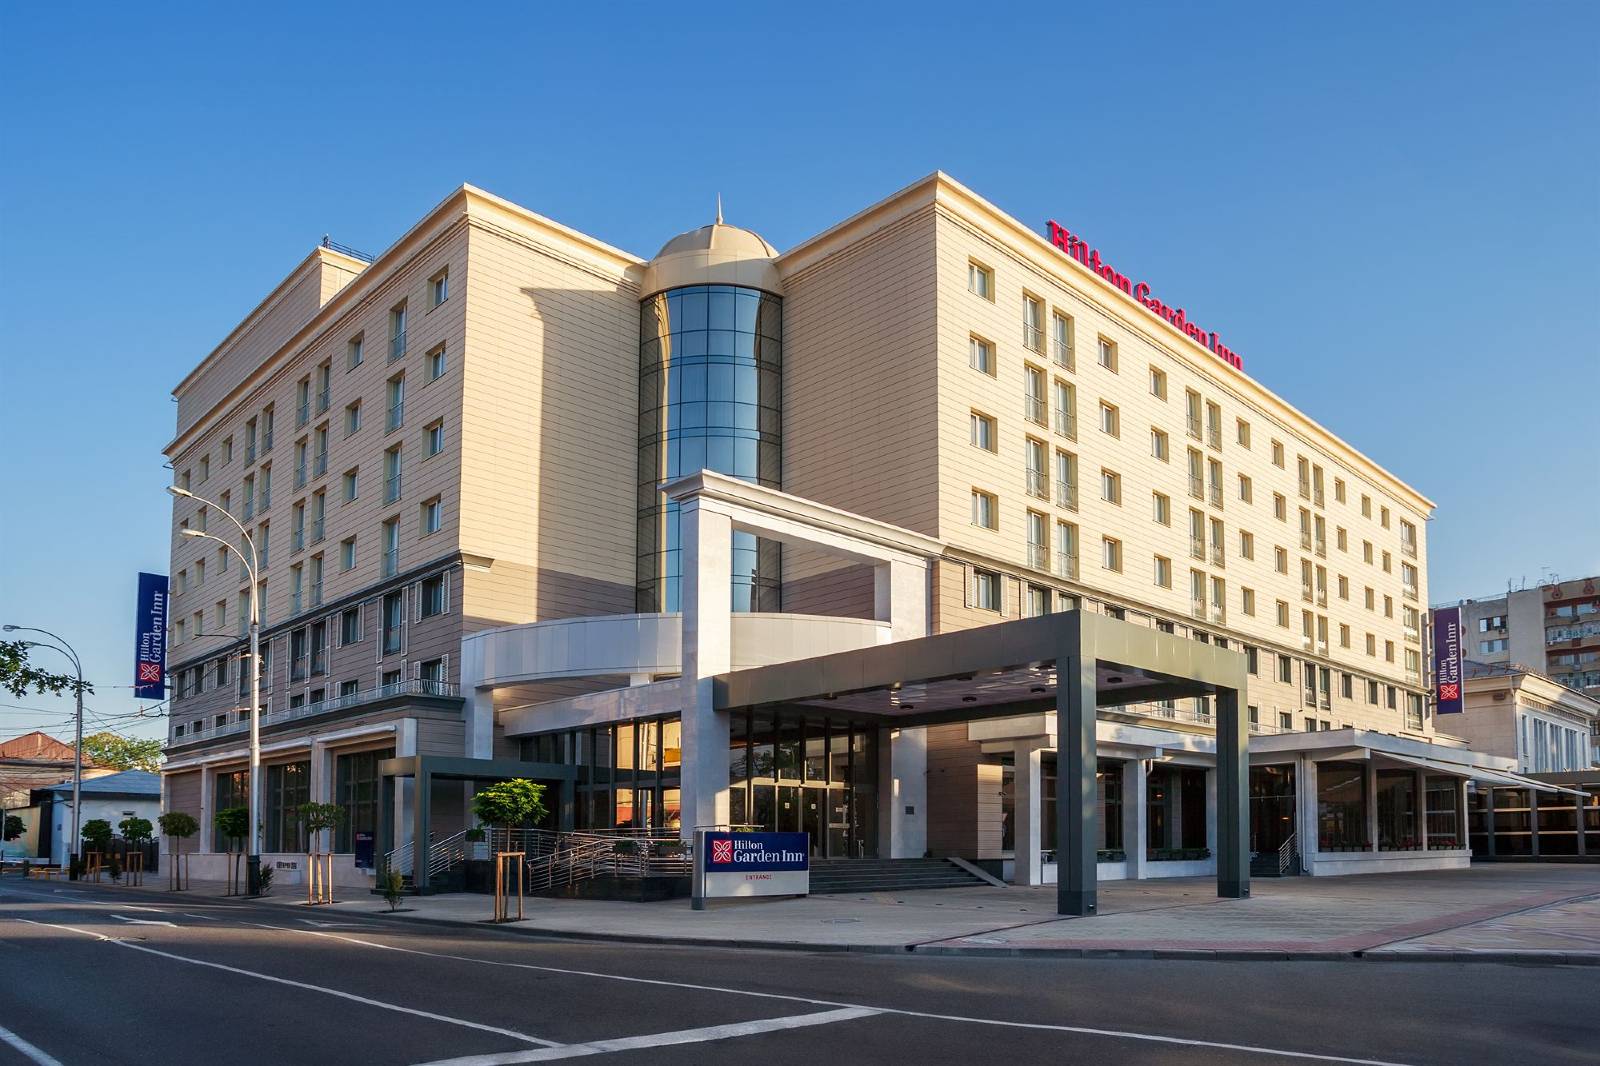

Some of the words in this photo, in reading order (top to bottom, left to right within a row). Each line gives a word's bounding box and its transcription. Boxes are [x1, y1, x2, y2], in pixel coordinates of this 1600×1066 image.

[1046, 218, 1132, 297] Hilton
[1134, 280, 1208, 347] Garden
[1209, 331, 1244, 371] Inn
[151, 593, 163, 616] Inn
[149, 617, 162, 663] Garden
[1446, 623, 1457, 645] Inn
[140, 632, 150, 661] Hilton
[1439, 660, 1447, 684] Hilton
[1446, 645, 1458, 684] Garden
[733, 850, 780, 863] Garden
[782, 850, 804, 862] Inn
[734, 840, 763, 850] Hilton
